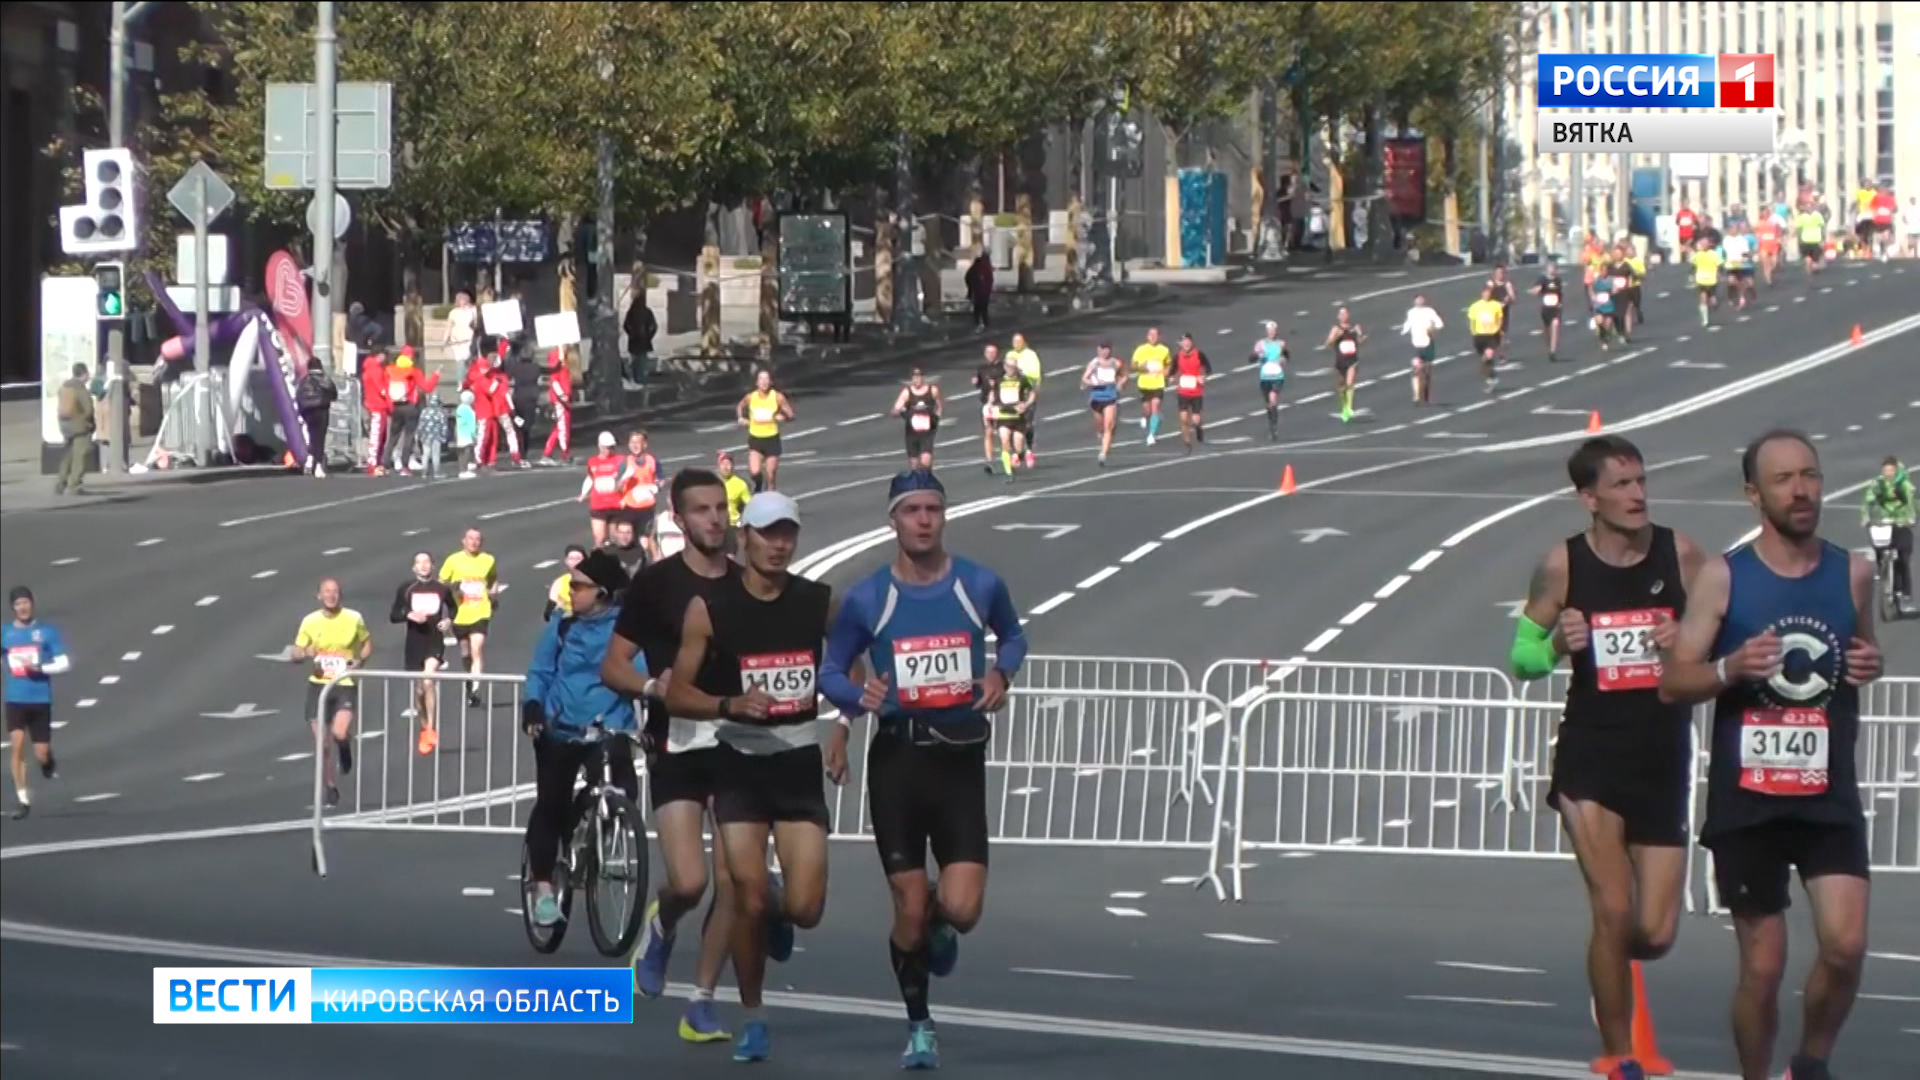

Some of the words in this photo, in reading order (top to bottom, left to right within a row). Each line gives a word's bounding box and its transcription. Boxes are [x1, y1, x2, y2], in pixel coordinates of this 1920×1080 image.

[905, 651, 960, 679] 9701
[746, 667, 813, 692] 11659
[1752, 729, 1818, 756] 3140
